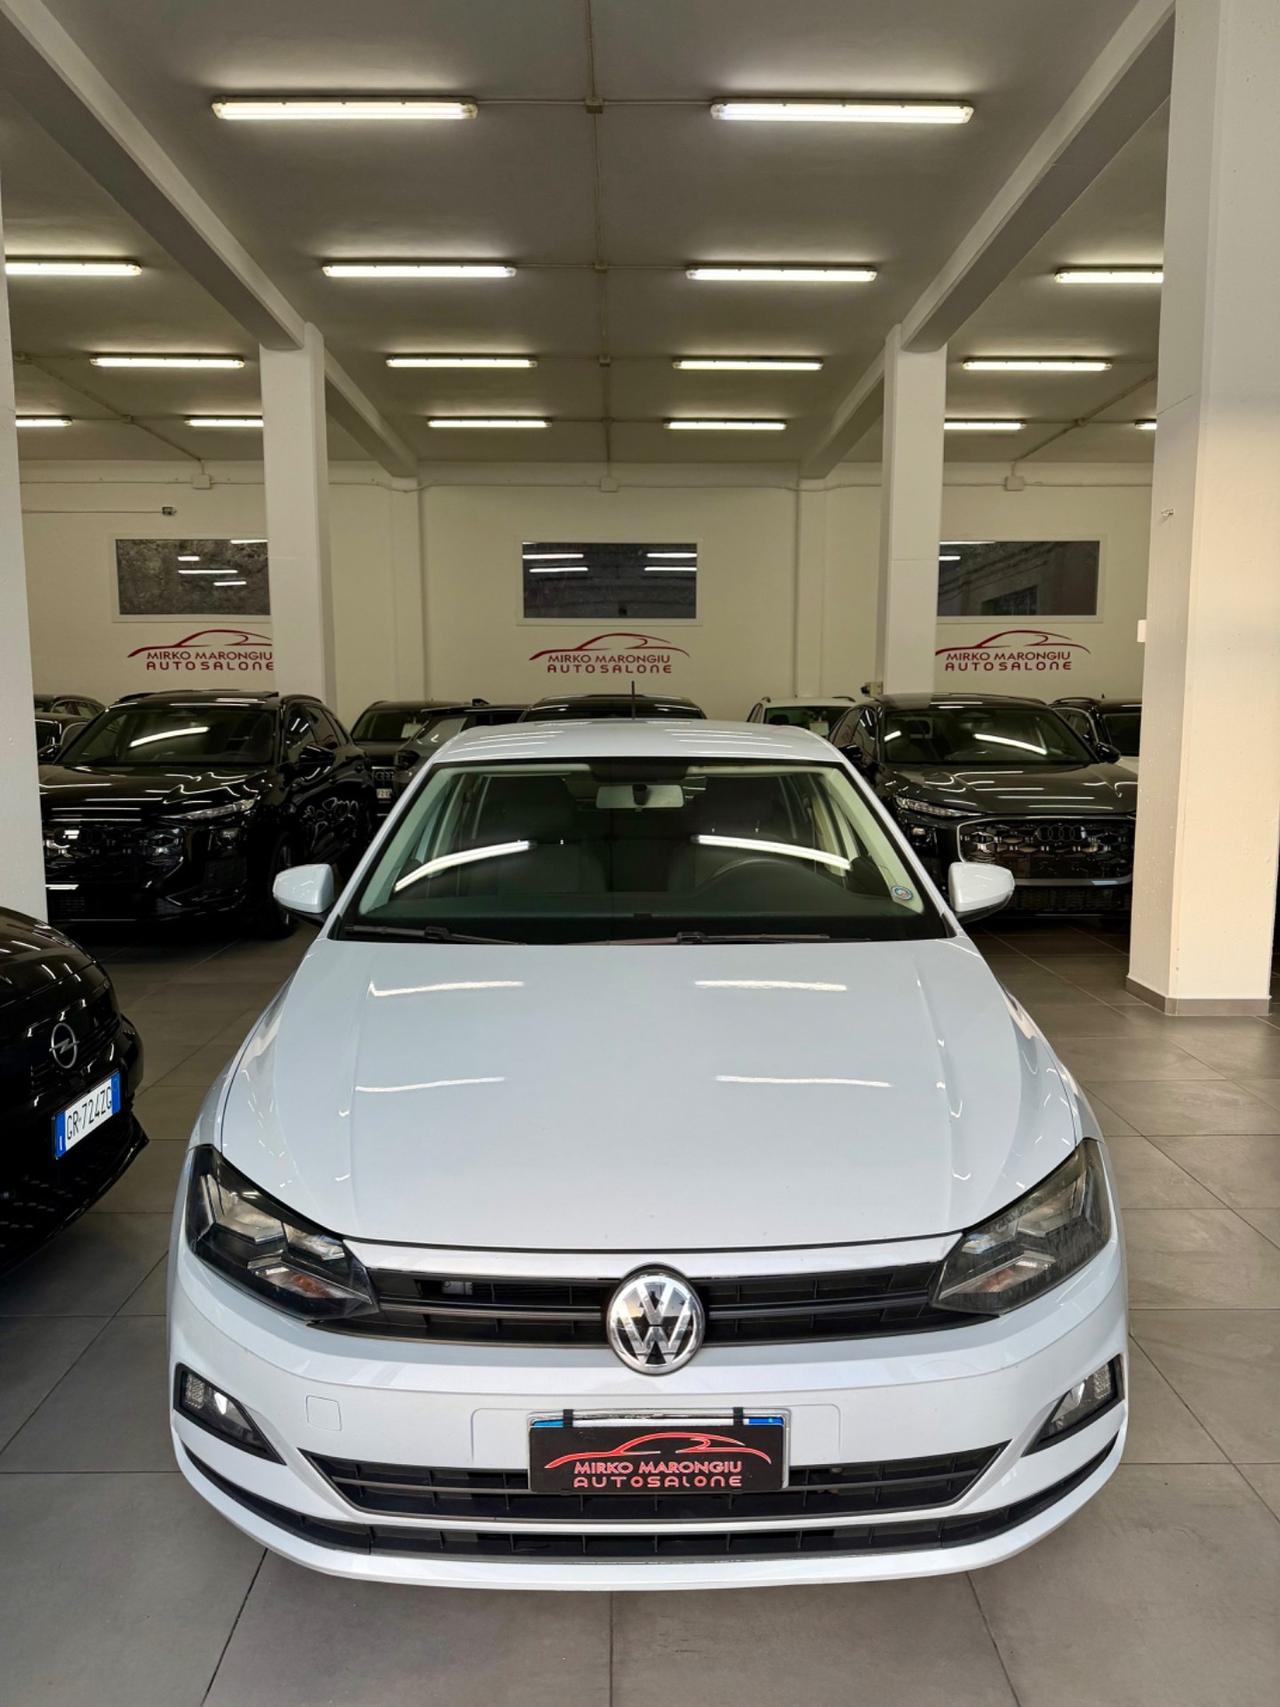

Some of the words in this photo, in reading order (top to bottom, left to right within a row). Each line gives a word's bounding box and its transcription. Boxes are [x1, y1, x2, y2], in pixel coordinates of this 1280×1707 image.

[146, 651, 191, 661] MIRKO
[194, 651, 273, 661] MARONGIU
[547, 654, 592, 664] MIRKO
[595, 654, 671, 664] MARONGIU
[946, 651, 991, 661] MIRKO
[994, 651, 1071, 661] MARONGIU
[146, 660, 274, 672] AUTOSALONE
[546, 663, 672, 674] AUTOSALONE
[944, 660, 1072, 672] AUTOSALONE
[573, 1461, 634, 1475] MIRKO
[639, 1461, 742, 1475] MARONGIU
[573, 1475, 743, 1488] AUTOSALONE
